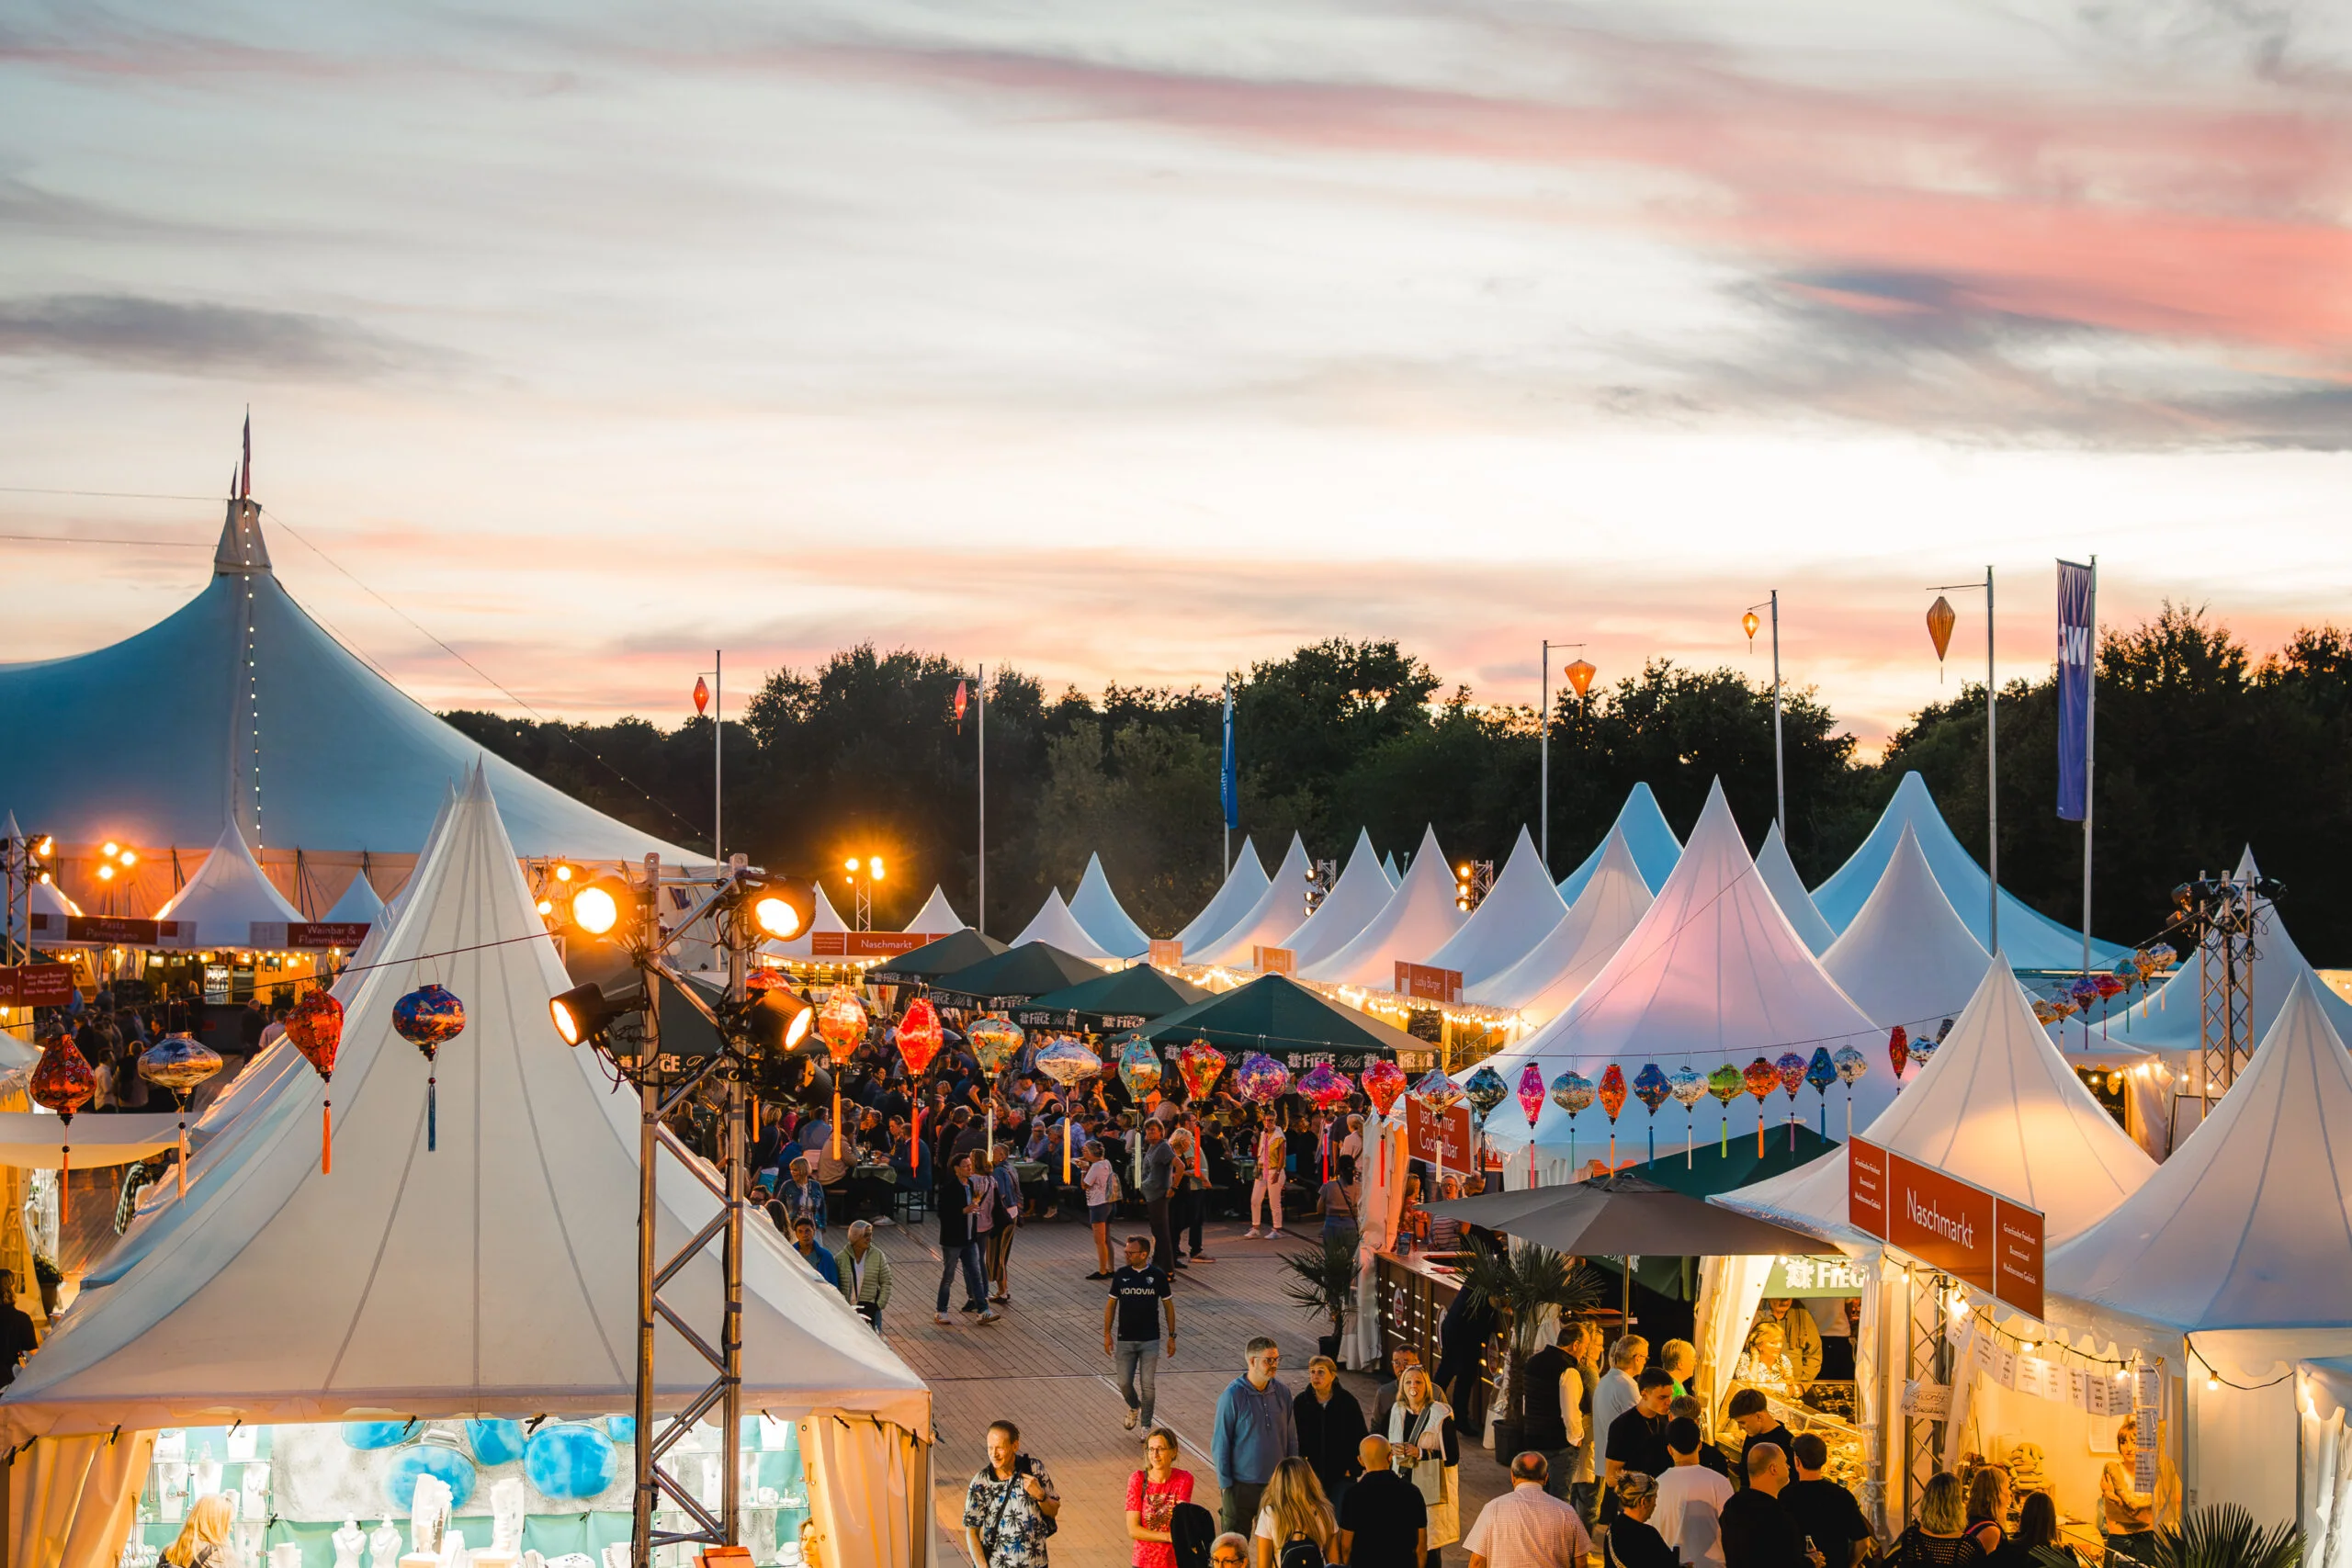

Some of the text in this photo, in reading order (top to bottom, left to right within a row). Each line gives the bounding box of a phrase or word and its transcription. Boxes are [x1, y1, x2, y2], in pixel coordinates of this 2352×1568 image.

[100, 919, 126, 930] Pasta
[348, 925, 356, 935] &
[861, 939, 912, 949] Naschmarkt
[1338, 1054, 1363, 1068] Pils
[1419, 1127, 1458, 1159] Cockailbar
[1907, 1187, 1973, 1249] Naschmarkt
[1816, 1262, 1866, 1288] FIEG
